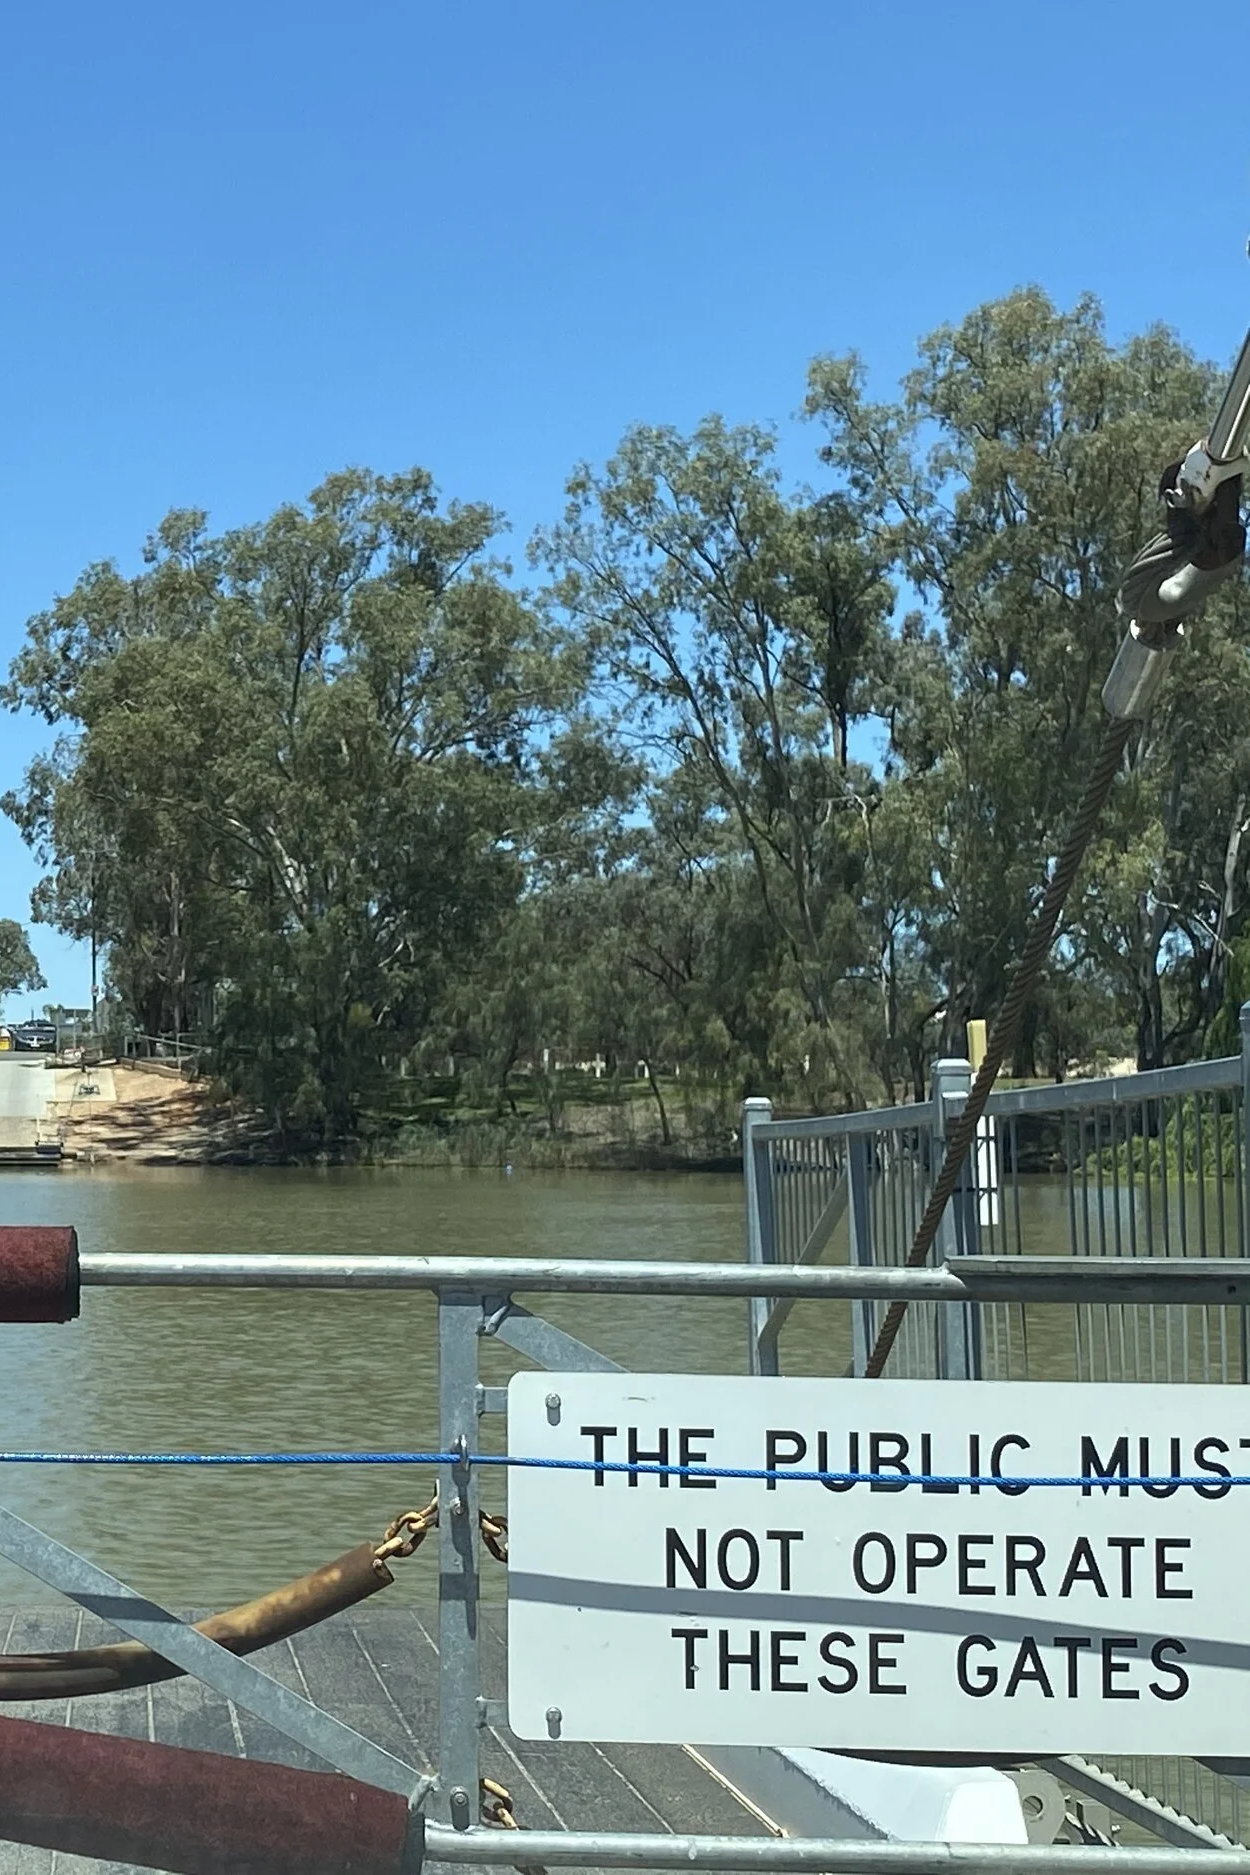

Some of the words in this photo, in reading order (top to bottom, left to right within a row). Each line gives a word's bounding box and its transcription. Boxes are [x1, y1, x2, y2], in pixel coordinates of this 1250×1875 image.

[581, 1426, 717, 1488] THE
[766, 1430, 1031, 1496] PUBLIC
[1081, 1436, 1250, 1500] MUS
[666, 1527, 804, 1591] NOT
[853, 1532, 1193, 1599] OPERATE
[671, 1628, 907, 1695] THESE
[957, 1634, 1189, 1701] GATES
